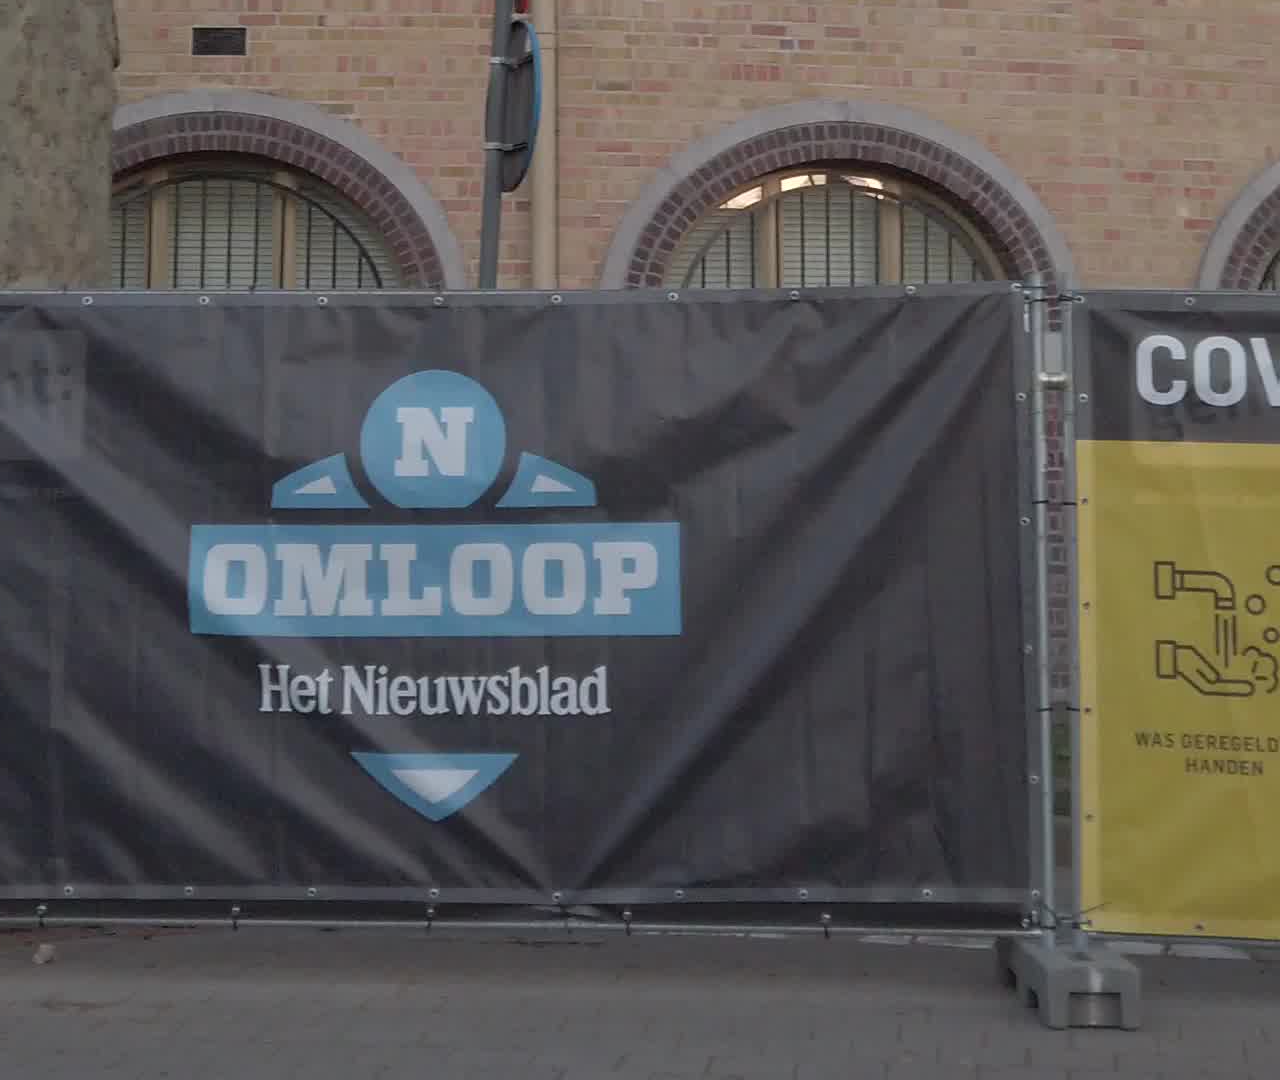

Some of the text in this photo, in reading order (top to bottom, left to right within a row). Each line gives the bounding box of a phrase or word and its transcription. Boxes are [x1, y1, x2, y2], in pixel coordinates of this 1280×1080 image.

[394, 406, 474, 477] N
[203, 541, 658, 617] OMLOOP
[257, 663, 611, 716] Het Nieuwsblad
[1135, 732, 1176, 749] WAS
[1181, 734, 1279, 754] GEREGELD
[1185, 757, 1264, 776] HANDEN
